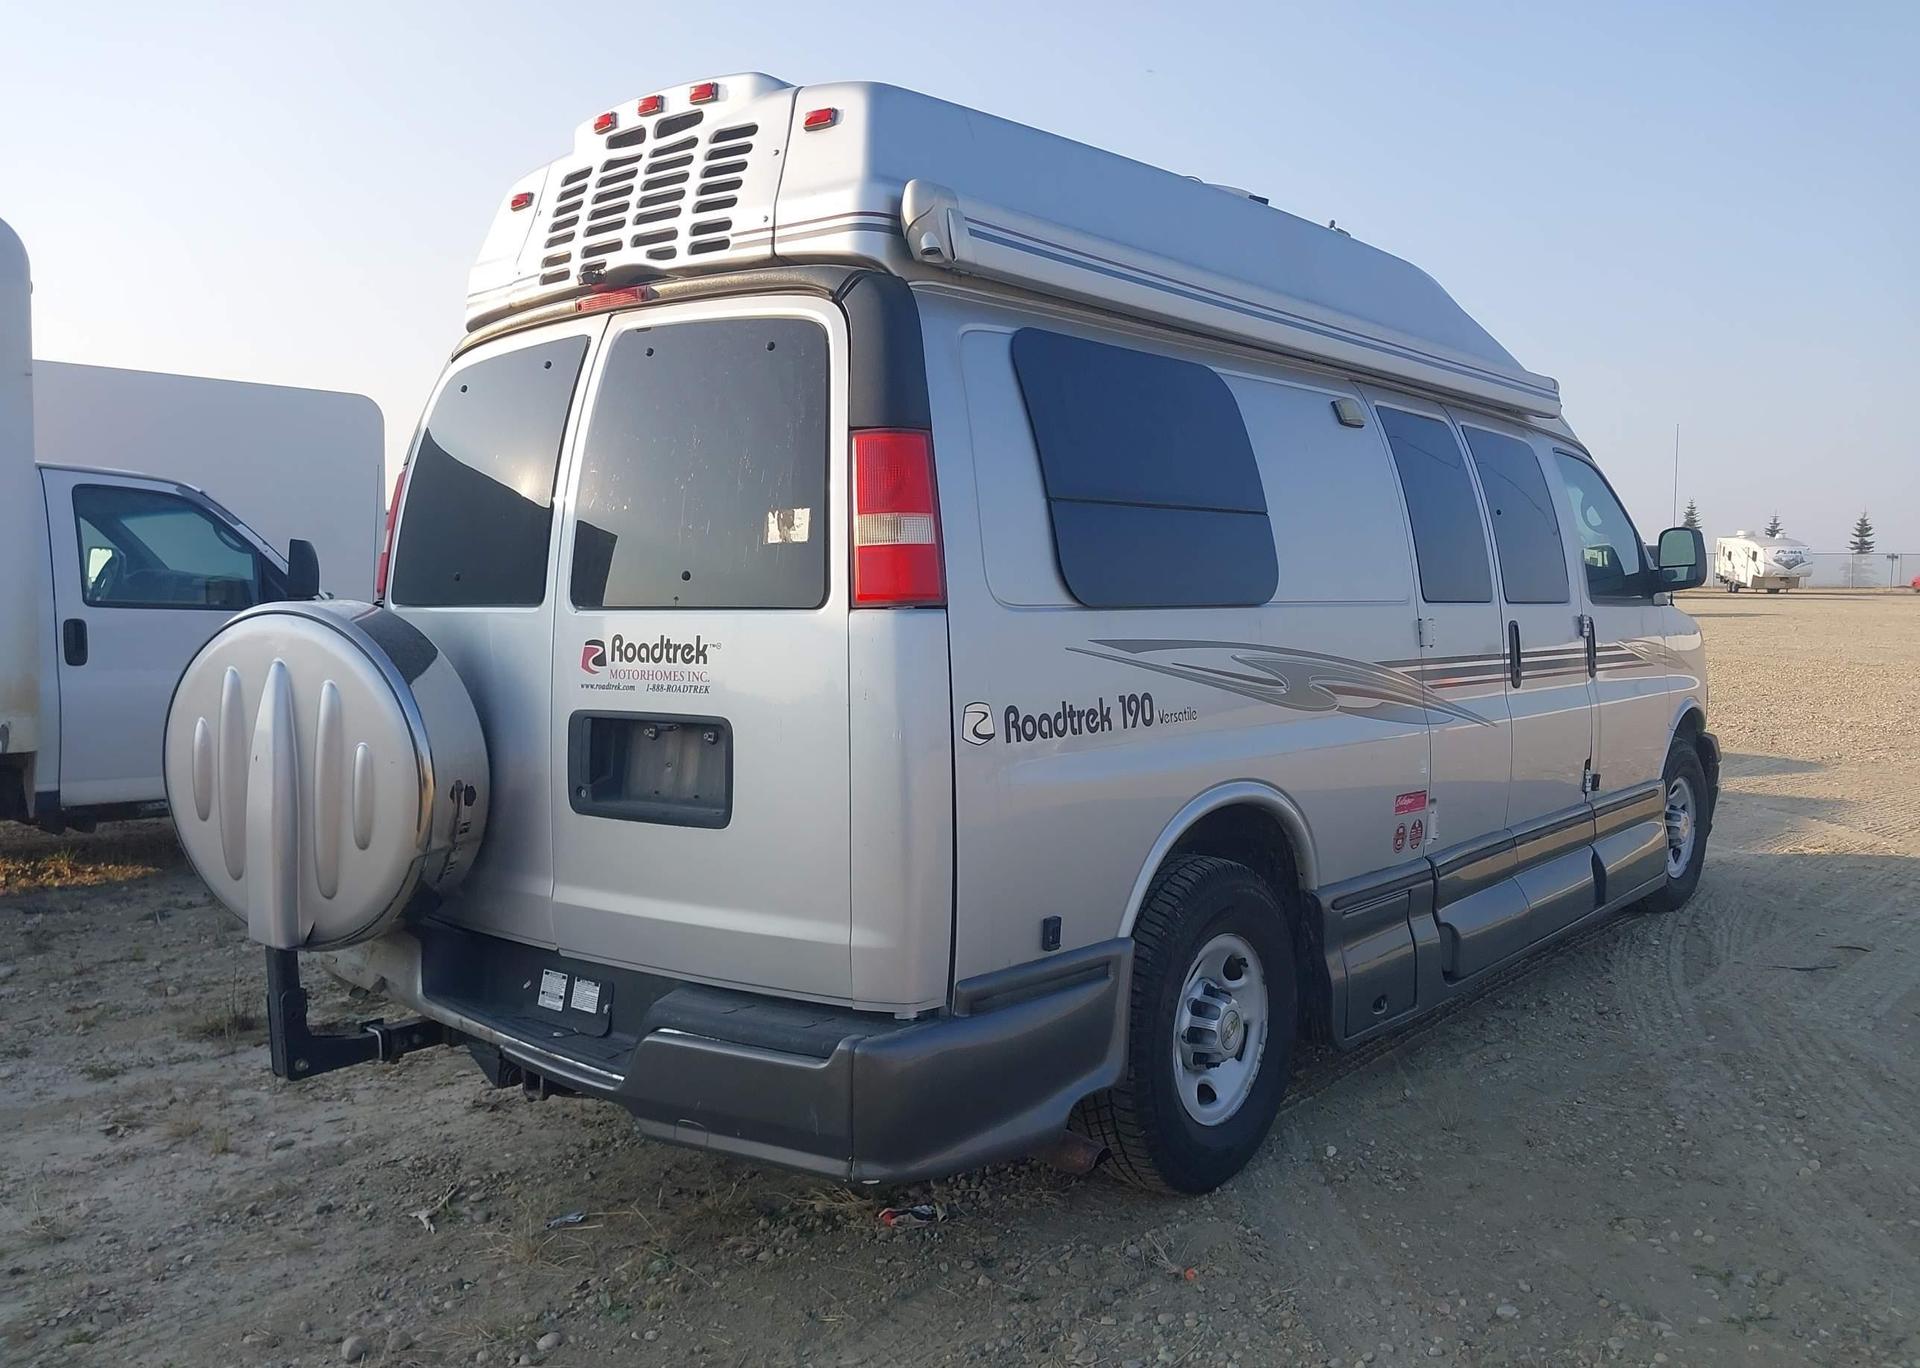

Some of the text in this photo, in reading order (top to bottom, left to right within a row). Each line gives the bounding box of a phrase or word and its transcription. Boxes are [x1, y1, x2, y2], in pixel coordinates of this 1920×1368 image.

[611, 634, 708, 664] Roadtrek
[609, 669, 710, 683] MOTORHOMES INC.
[580, 682, 710, 694] www.roadtrek.com 1-888-ROADTREK
[1004, 692, 1198, 743] Roadtrek 190 Versatile
